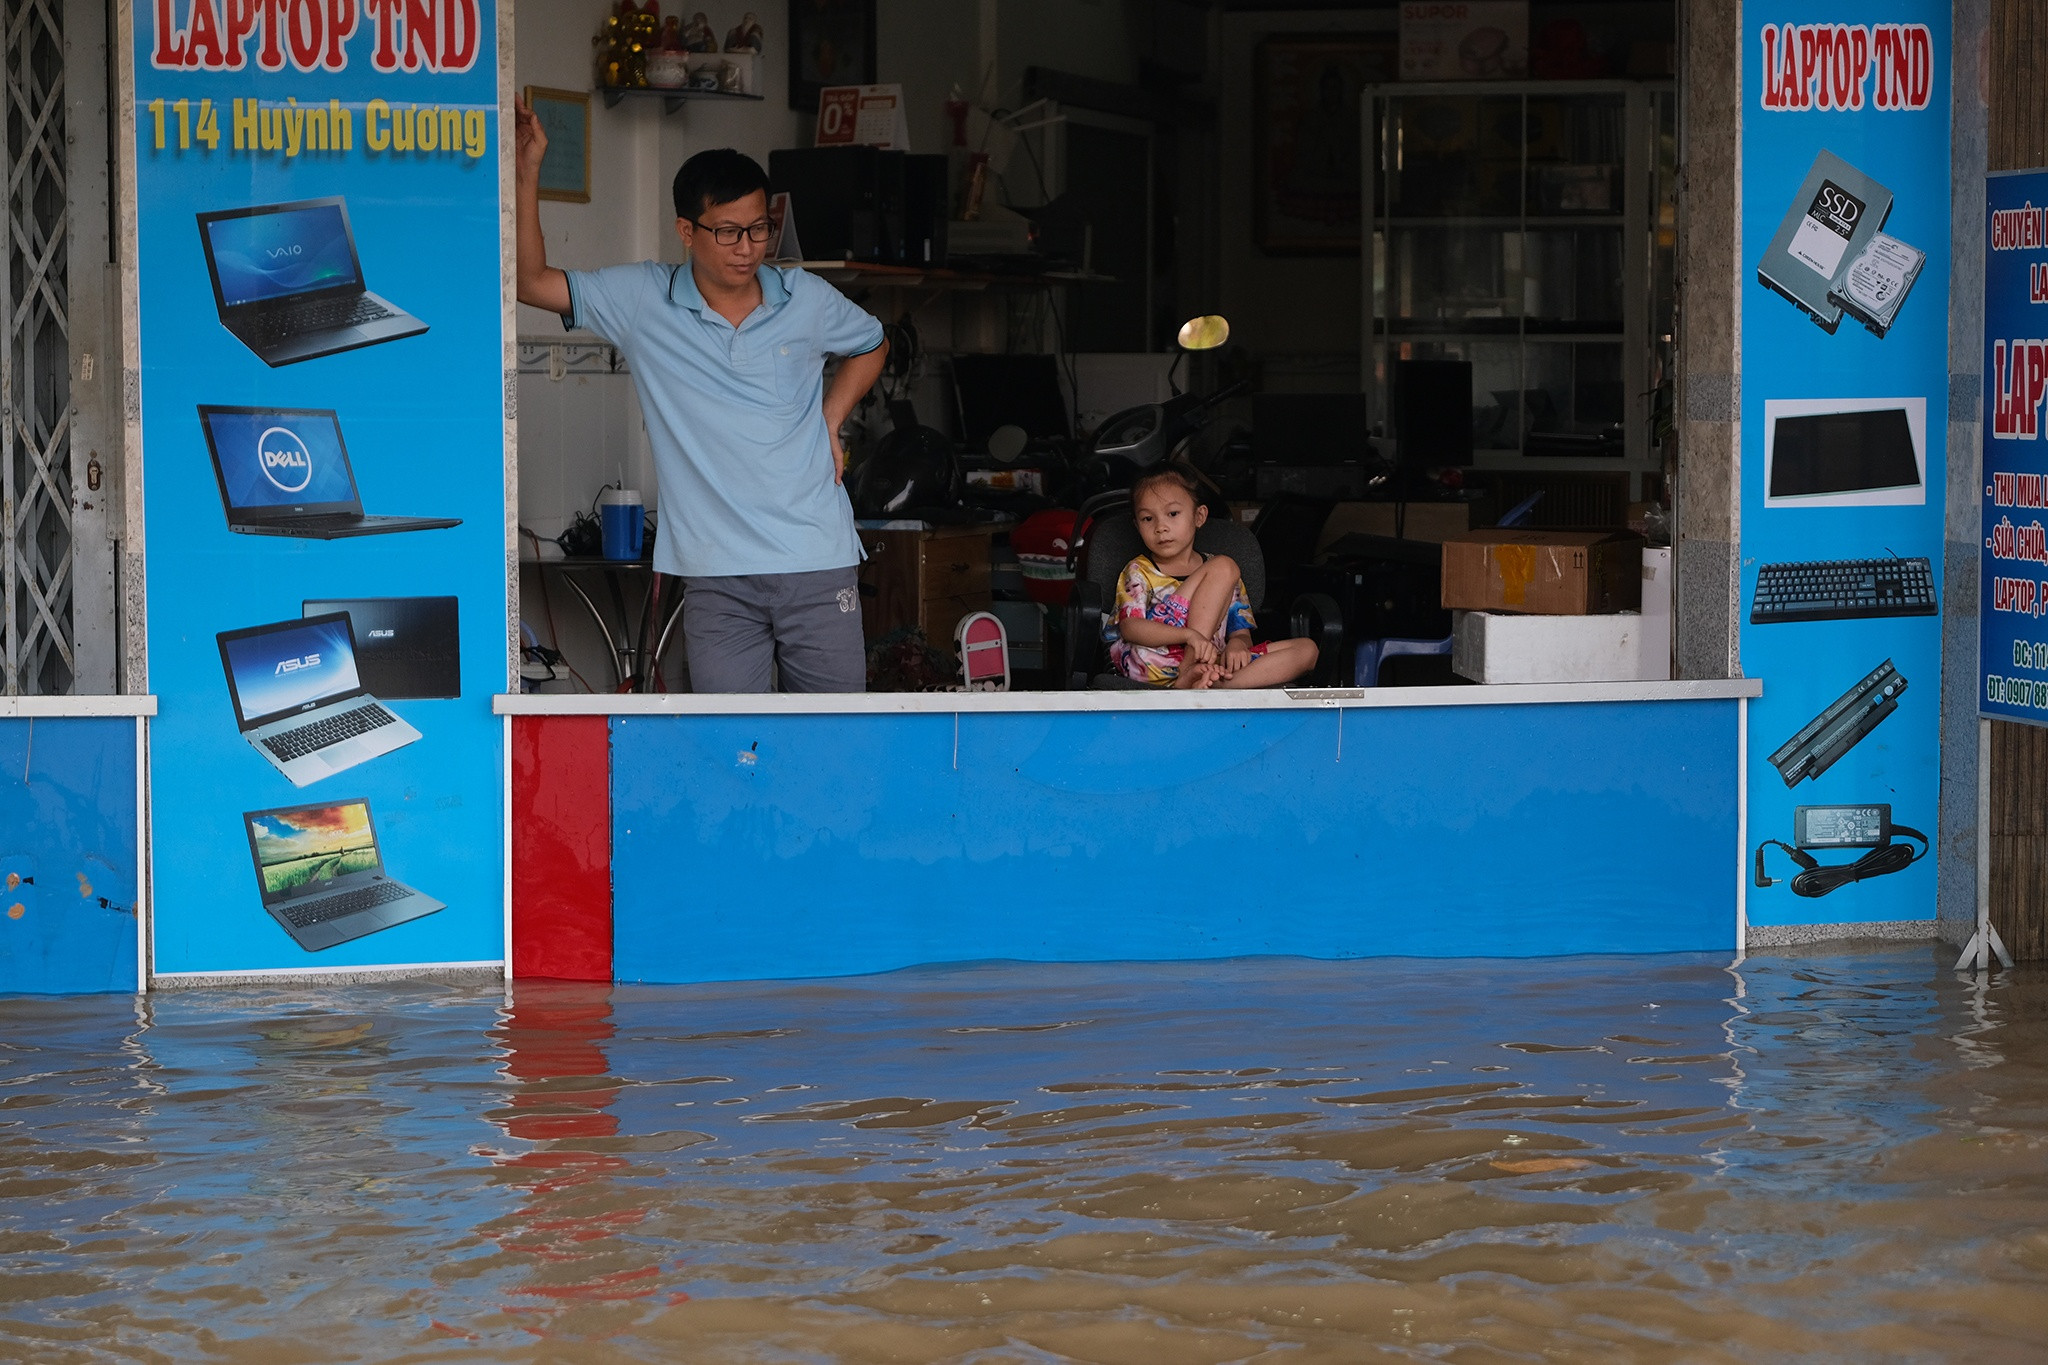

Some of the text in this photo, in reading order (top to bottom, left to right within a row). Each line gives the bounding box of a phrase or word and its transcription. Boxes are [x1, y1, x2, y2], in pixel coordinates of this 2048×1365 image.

[151, 0, 481, 73] LAPTOP TND
[1761, 23, 1934, 112] LAPTOP TND
[148, 97, 220, 150] 114
[233, 96, 352, 158] Huỳnh
[365, 98, 486, 158] Cương
[1818, 186, 1859, 224] SSD
[1991, 200, 2043, 251] CHUYÊN
[265, 243, 303, 259] VAIO
[264, 449, 307, 469] DELL
[1993, 471, 2015, 507] THU
[2016, 473, 2042, 509] MUA
[1992, 515, 2016, 559] SỬA
[1993, 576, 2038, 619] LAPTOP,
[368, 629, 395, 637] ASUS
[274, 653, 321, 675] ASUS
[2013, 638, 2048, 671] ĐC: 11
[1987, 674, 2005, 703] ĐT:
[2005, 678, 2032, 708] 0907
